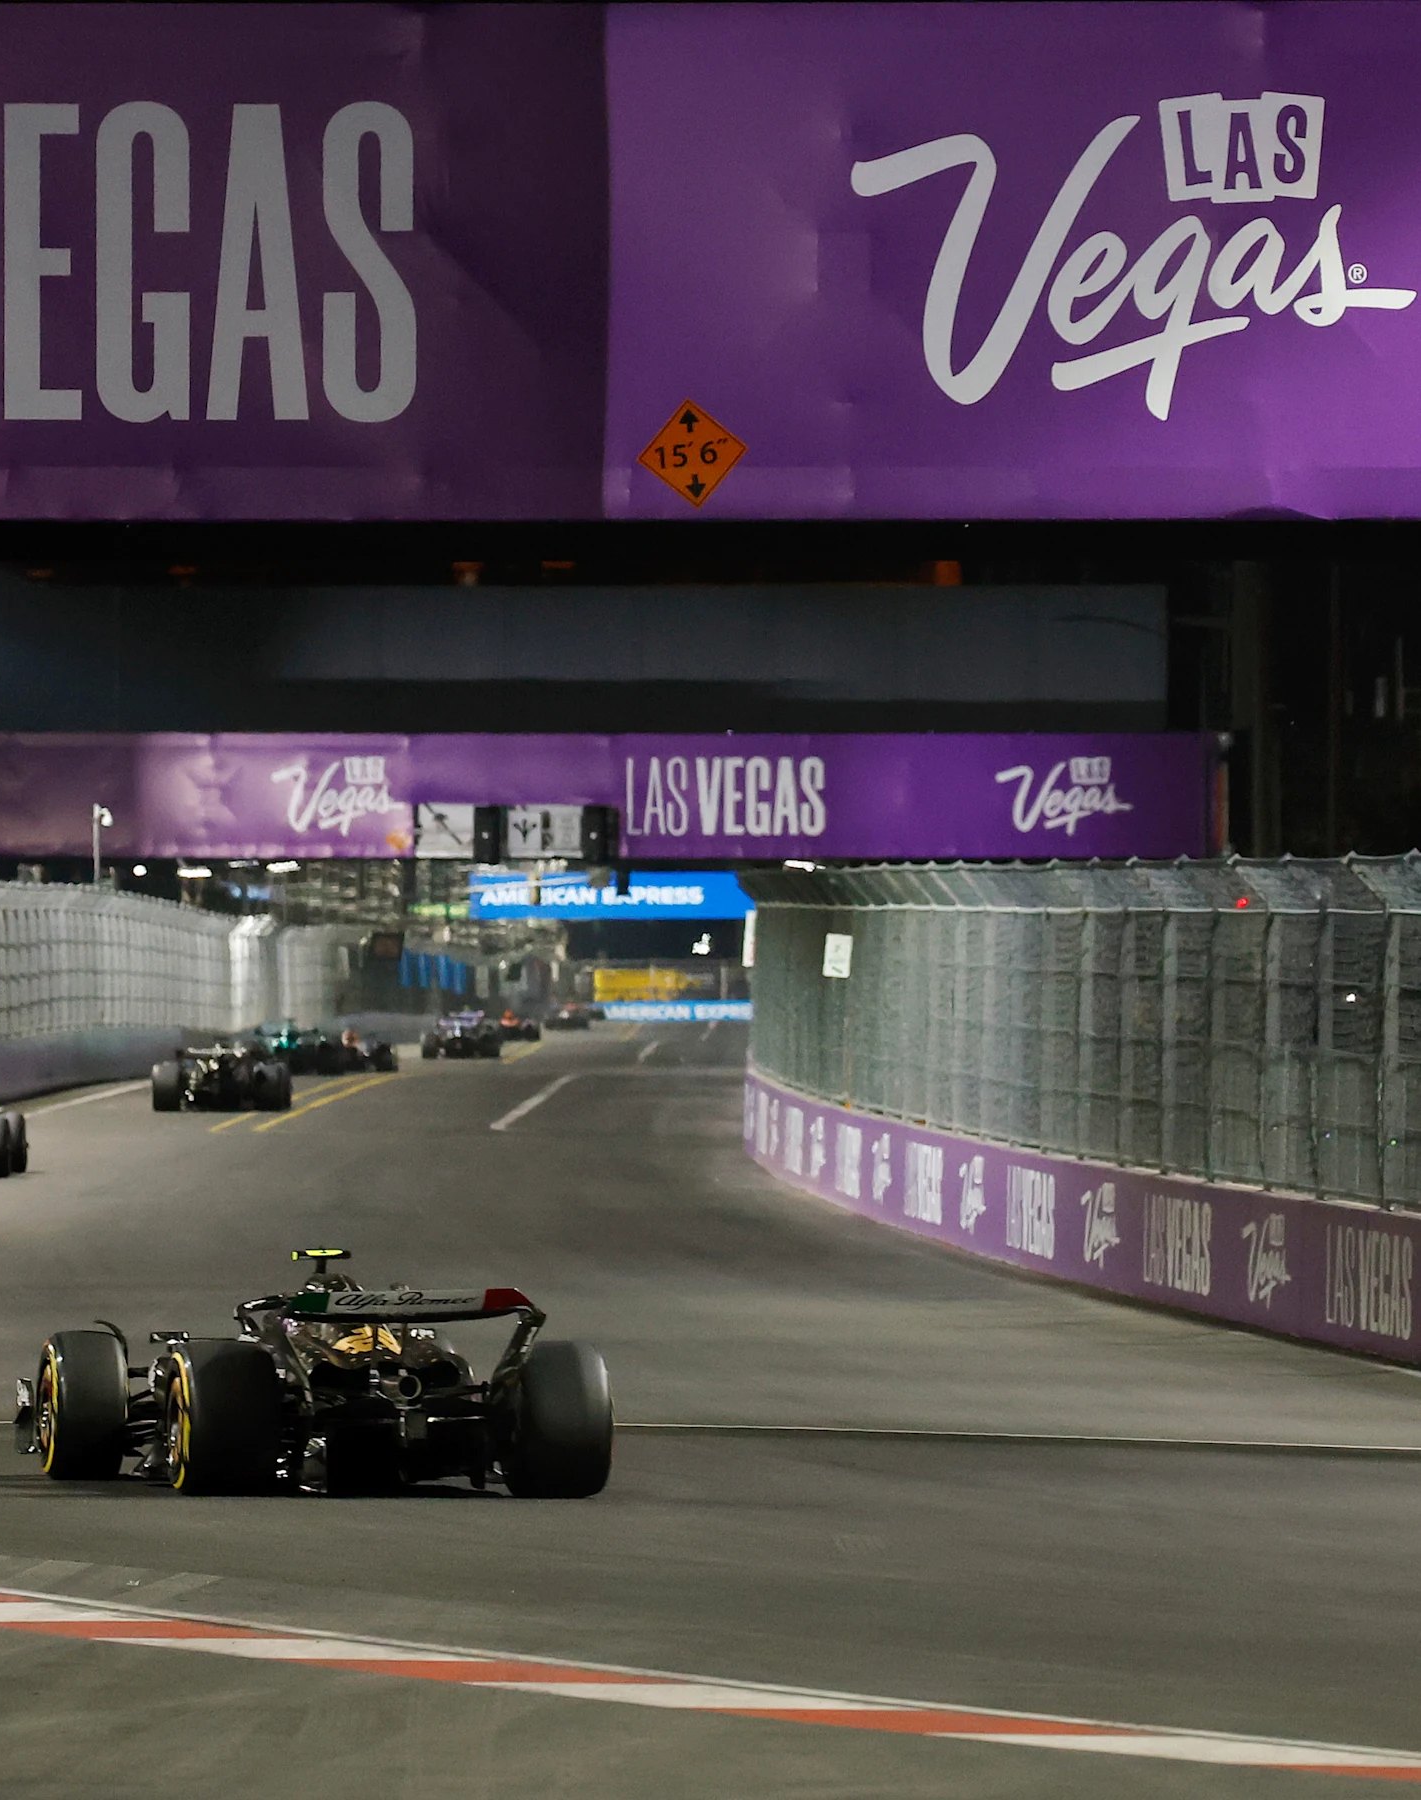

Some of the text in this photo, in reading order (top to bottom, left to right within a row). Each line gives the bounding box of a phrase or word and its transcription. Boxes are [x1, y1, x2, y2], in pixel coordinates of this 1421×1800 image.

[1172, 102, 1312, 193] LAS
[851, 115, 1417, 421] Vegas
[271, 759, 406, 836] Vegas
[626, 757, 825, 836] LAS VEGAS
[995, 761, 1134, 836] Vegas
[335, 1292, 476, 1310] Alfa Romeo
[1326, 1223, 1413, 1340] LAS VEGAS
